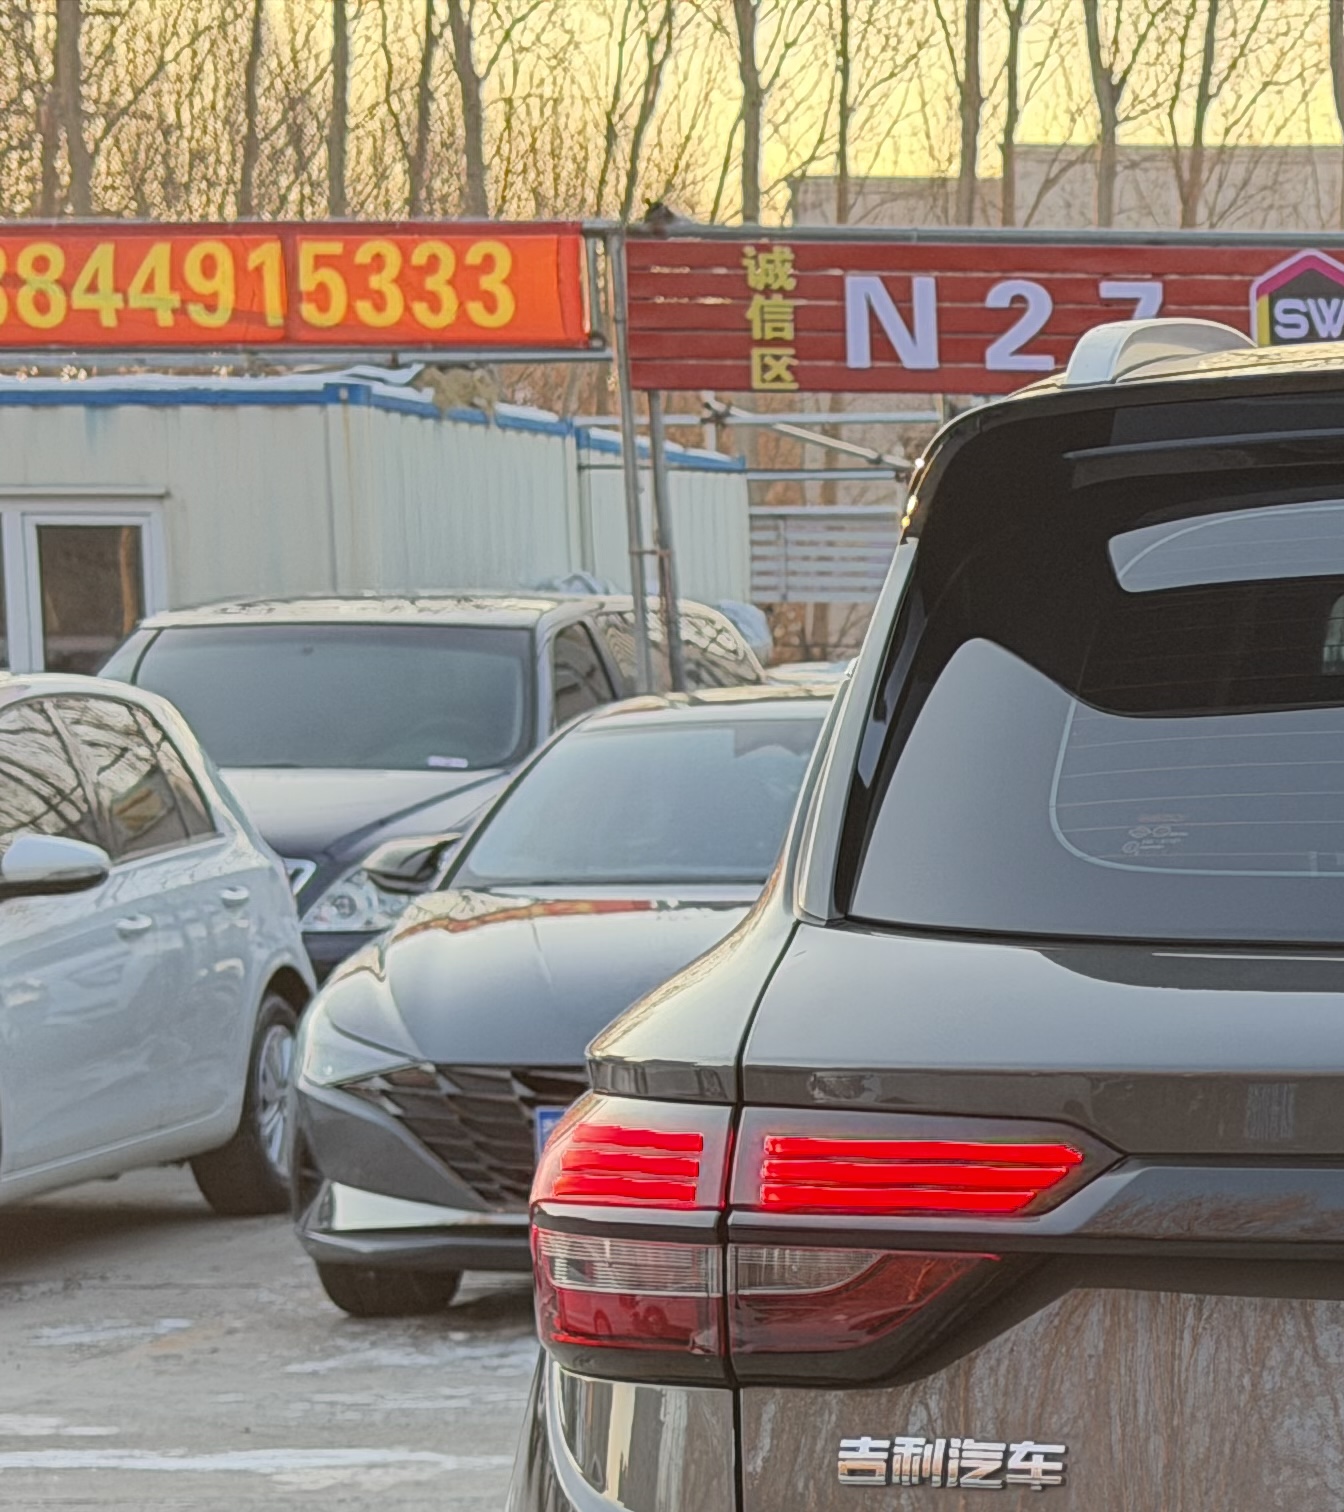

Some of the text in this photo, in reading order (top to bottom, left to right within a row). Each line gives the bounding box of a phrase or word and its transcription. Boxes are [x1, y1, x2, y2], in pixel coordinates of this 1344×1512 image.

[0, 239, 515, 329] 844915333
[742, 244, 800, 391] 诚信区
[837, 1436, 1067, 1491] 吉利汽车
